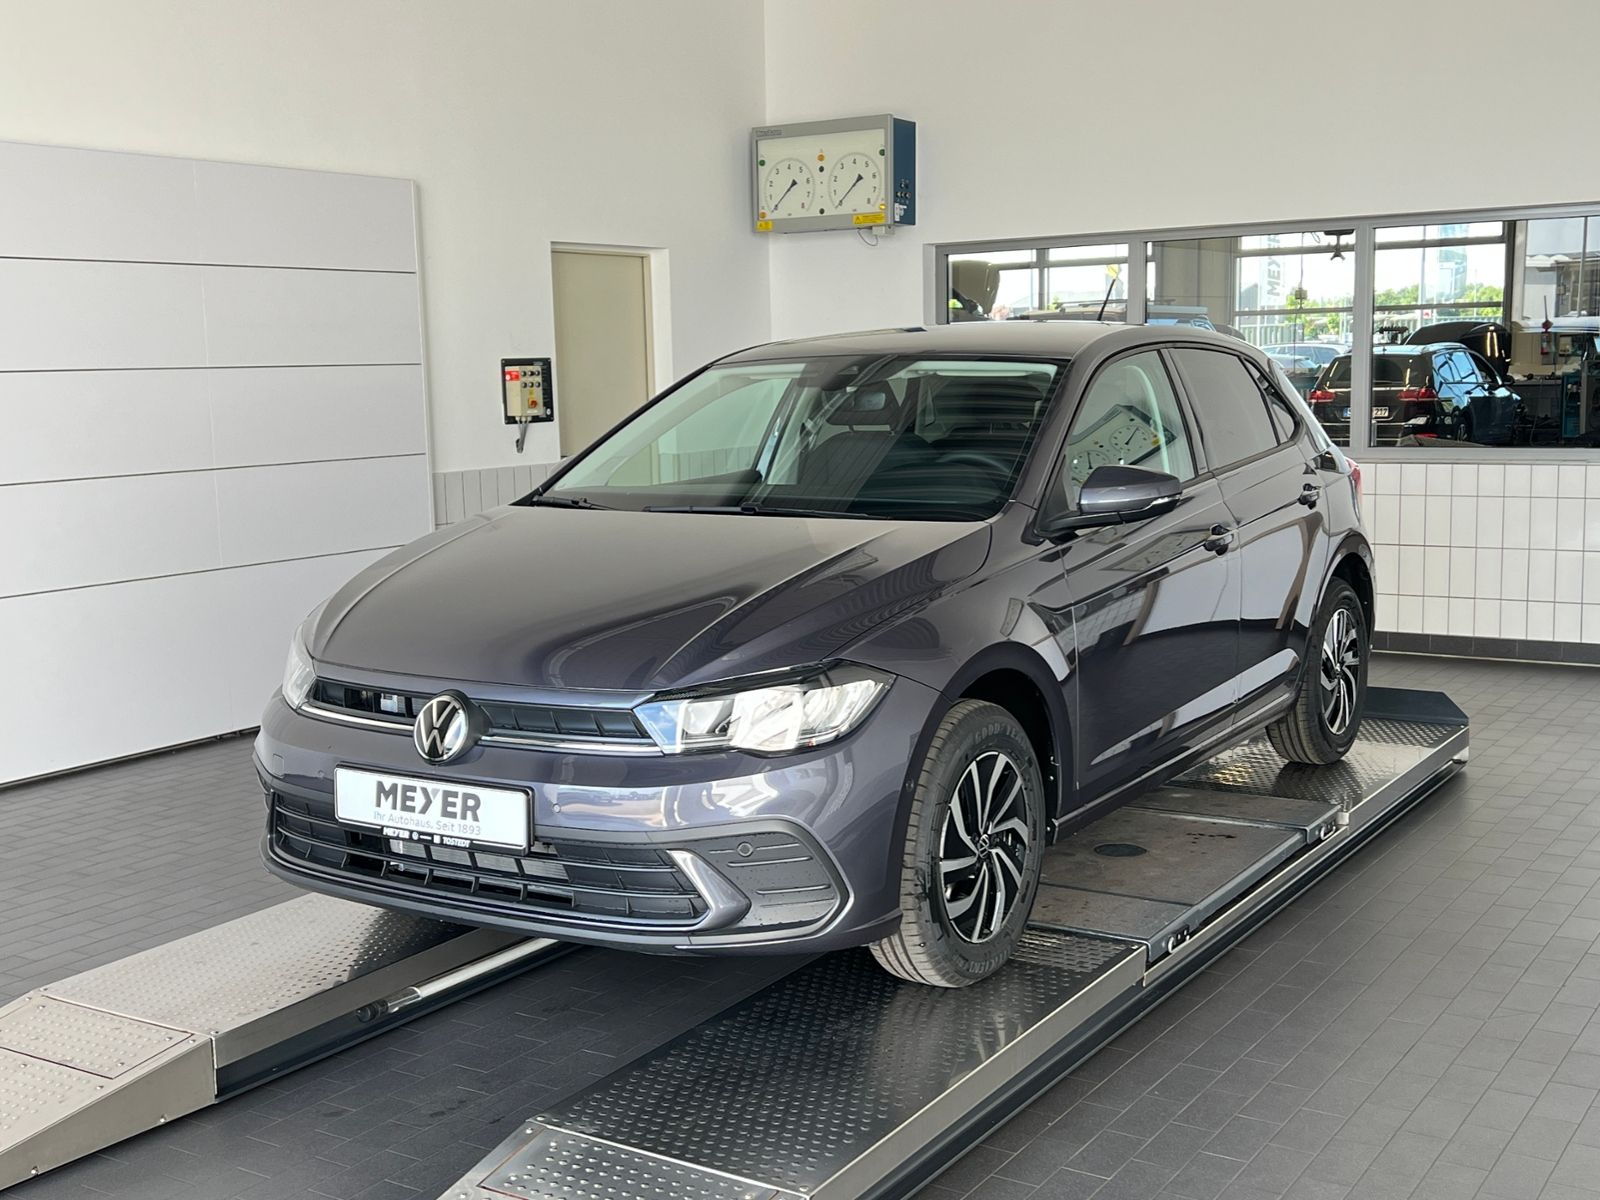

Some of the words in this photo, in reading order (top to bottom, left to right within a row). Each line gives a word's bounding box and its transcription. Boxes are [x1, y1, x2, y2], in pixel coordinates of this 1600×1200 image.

[375, 780, 482, 822] MEYER
[436, 820, 455, 832] Seit
[458, 823, 481, 835] 1893
